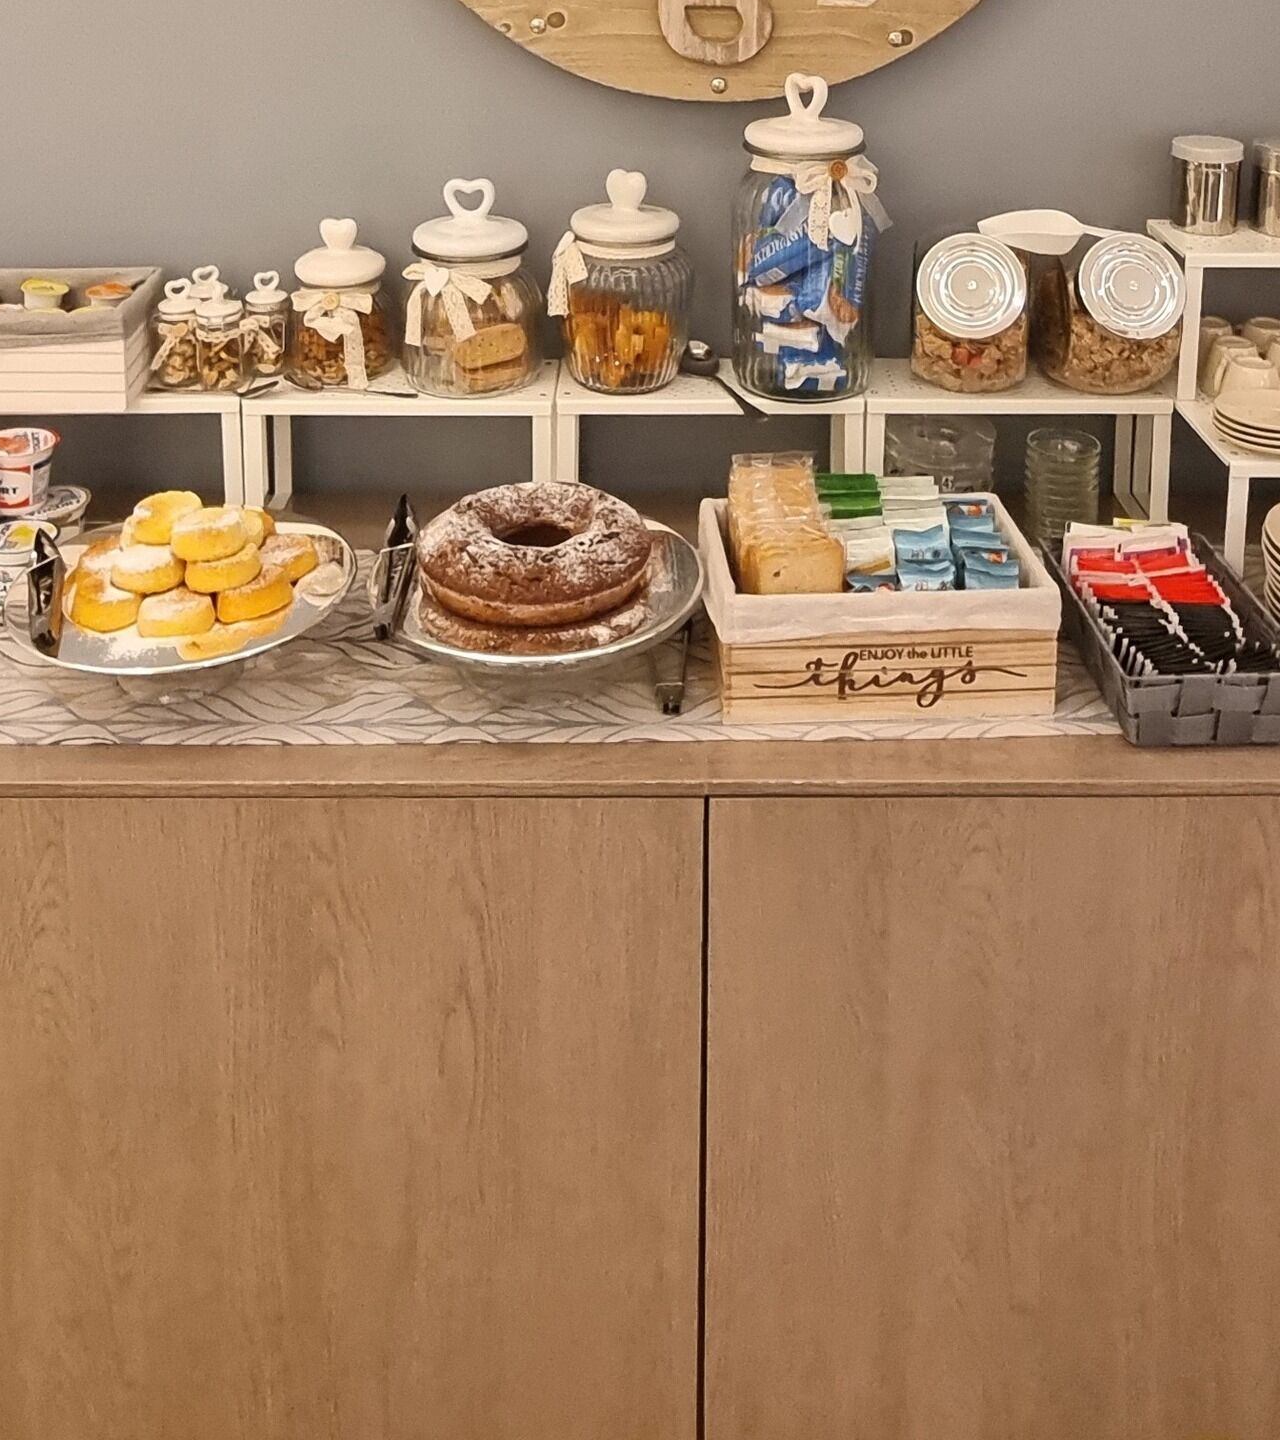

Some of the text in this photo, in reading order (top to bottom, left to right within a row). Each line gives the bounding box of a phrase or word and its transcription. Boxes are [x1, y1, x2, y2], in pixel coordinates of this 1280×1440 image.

[859, 646, 974, 661] ENJOY the LITTLE
[754, 651, 1027, 708] things
